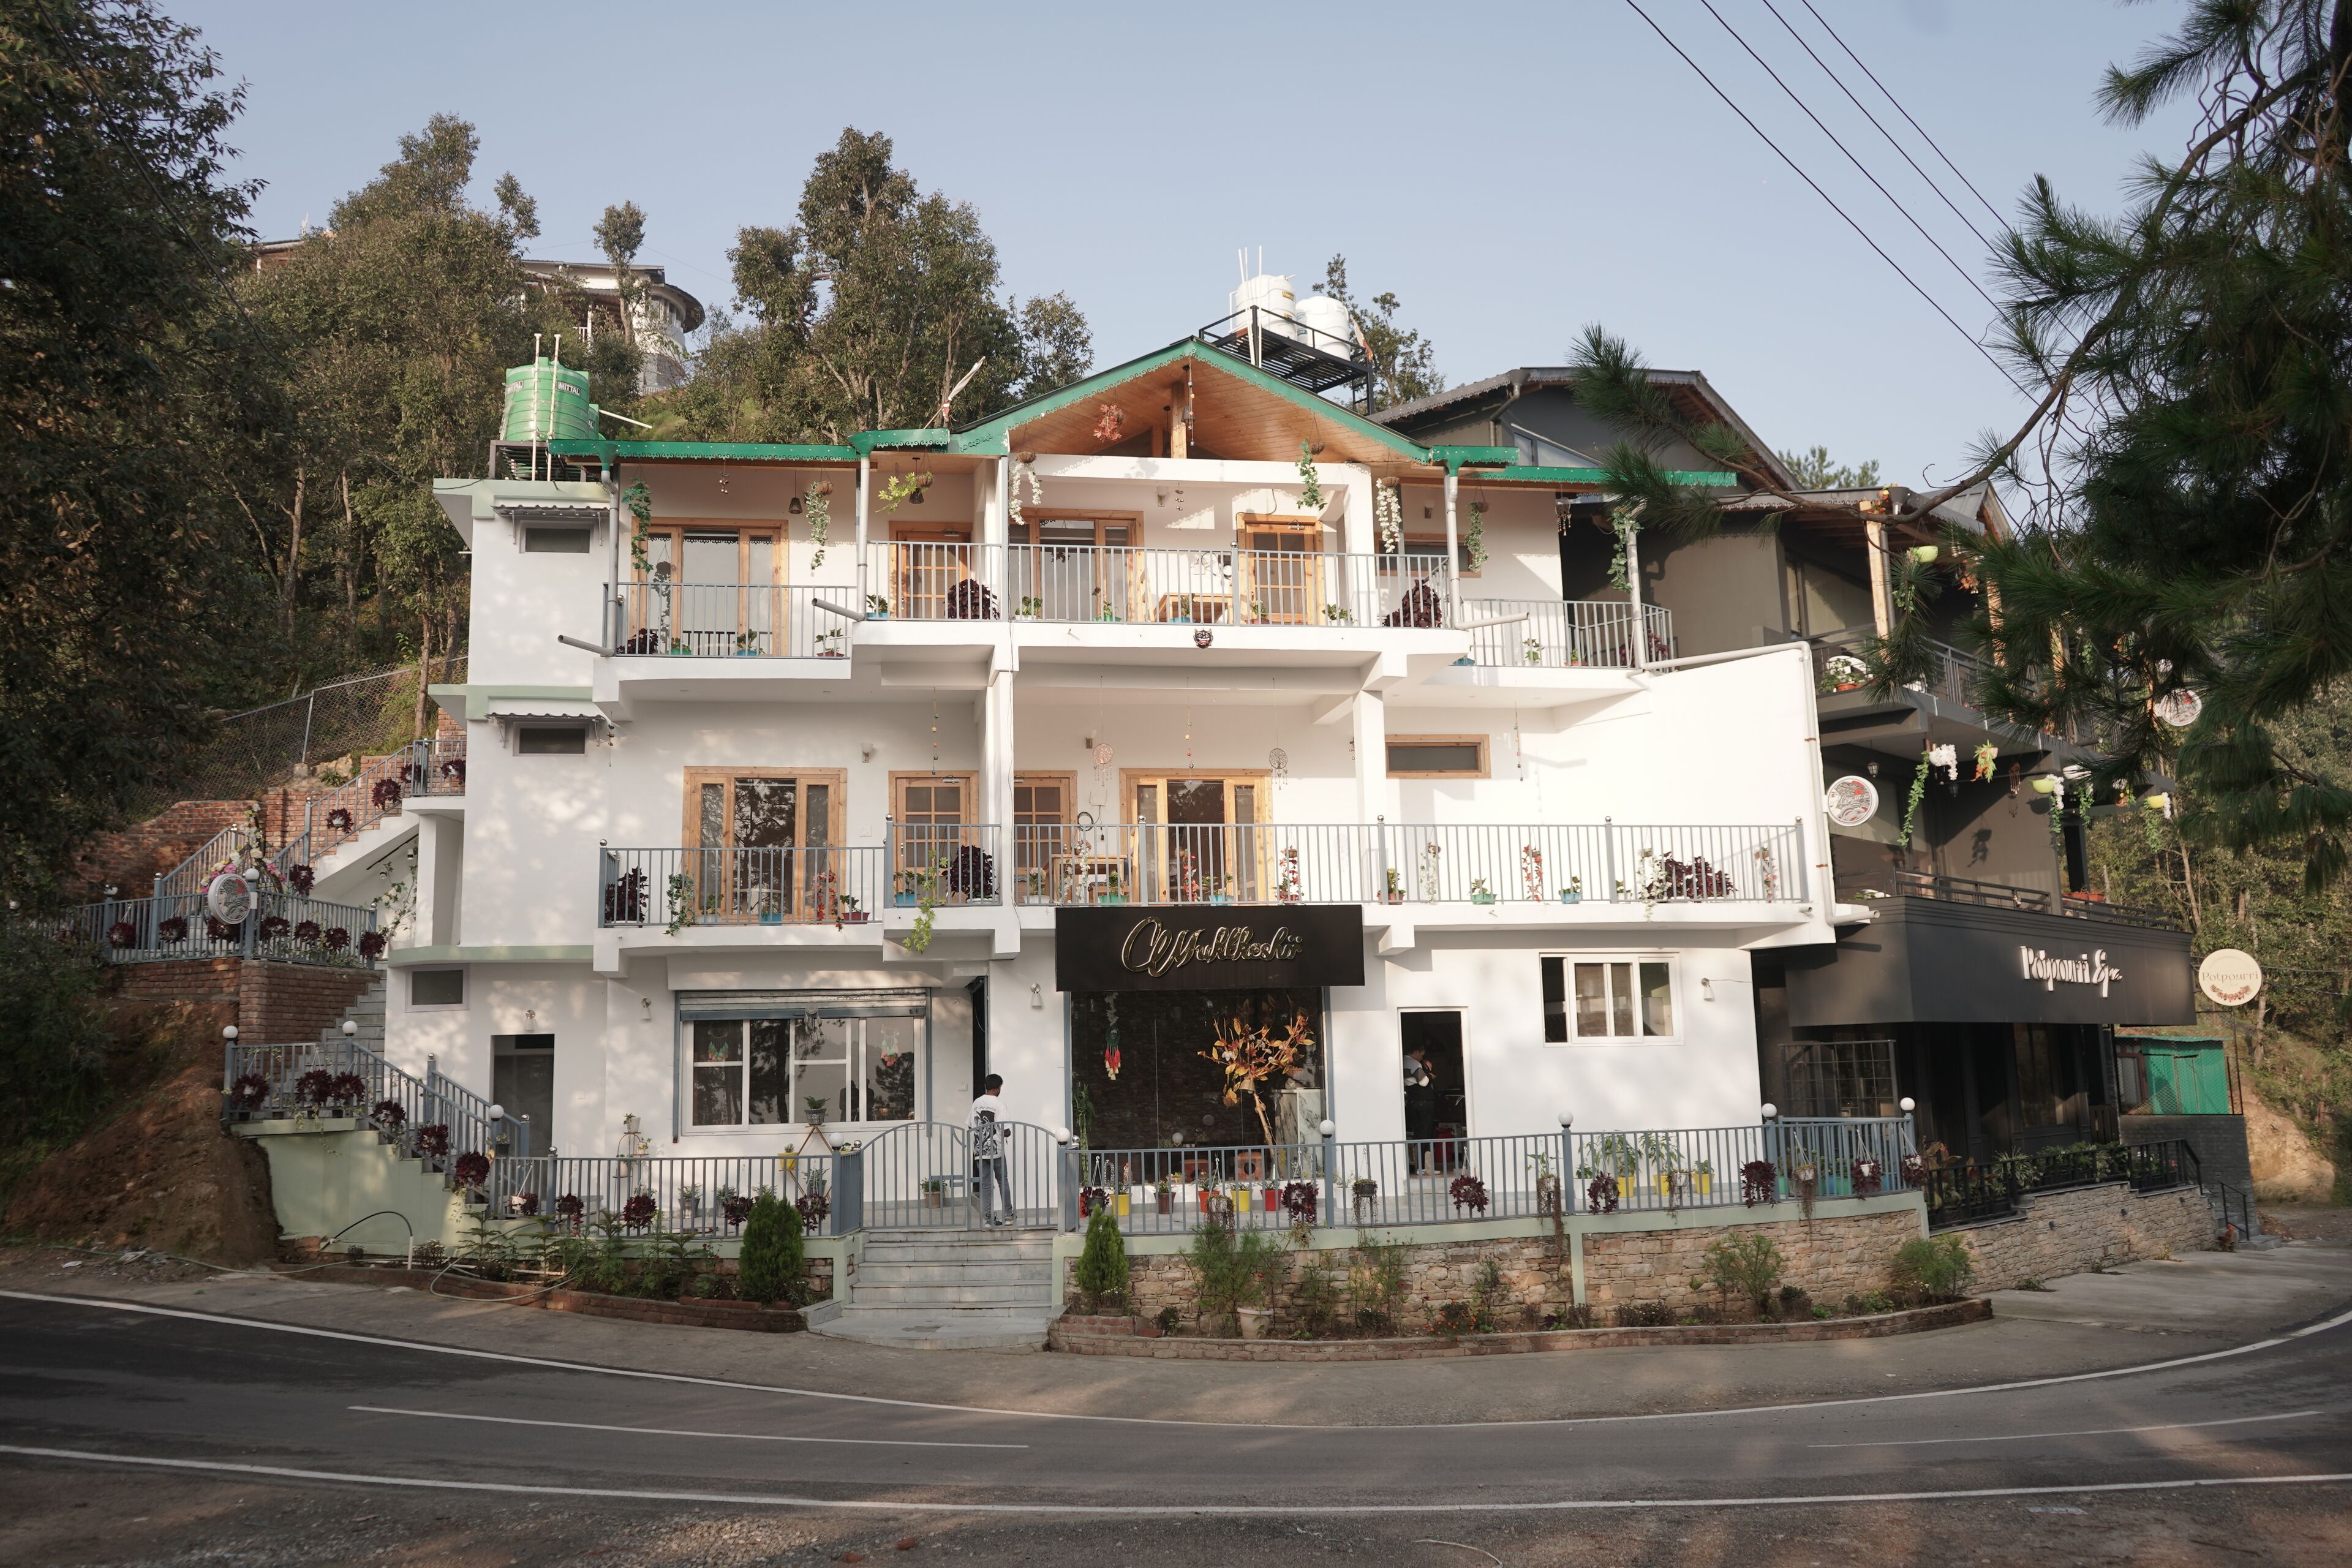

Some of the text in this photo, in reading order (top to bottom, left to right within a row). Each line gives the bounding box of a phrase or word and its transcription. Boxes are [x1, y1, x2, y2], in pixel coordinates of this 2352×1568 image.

[558, 382, 580, 395] MITTAL
[2020, 945, 2091, 992] Potpourri
[2201, 971, 2260, 984] Potpourri
